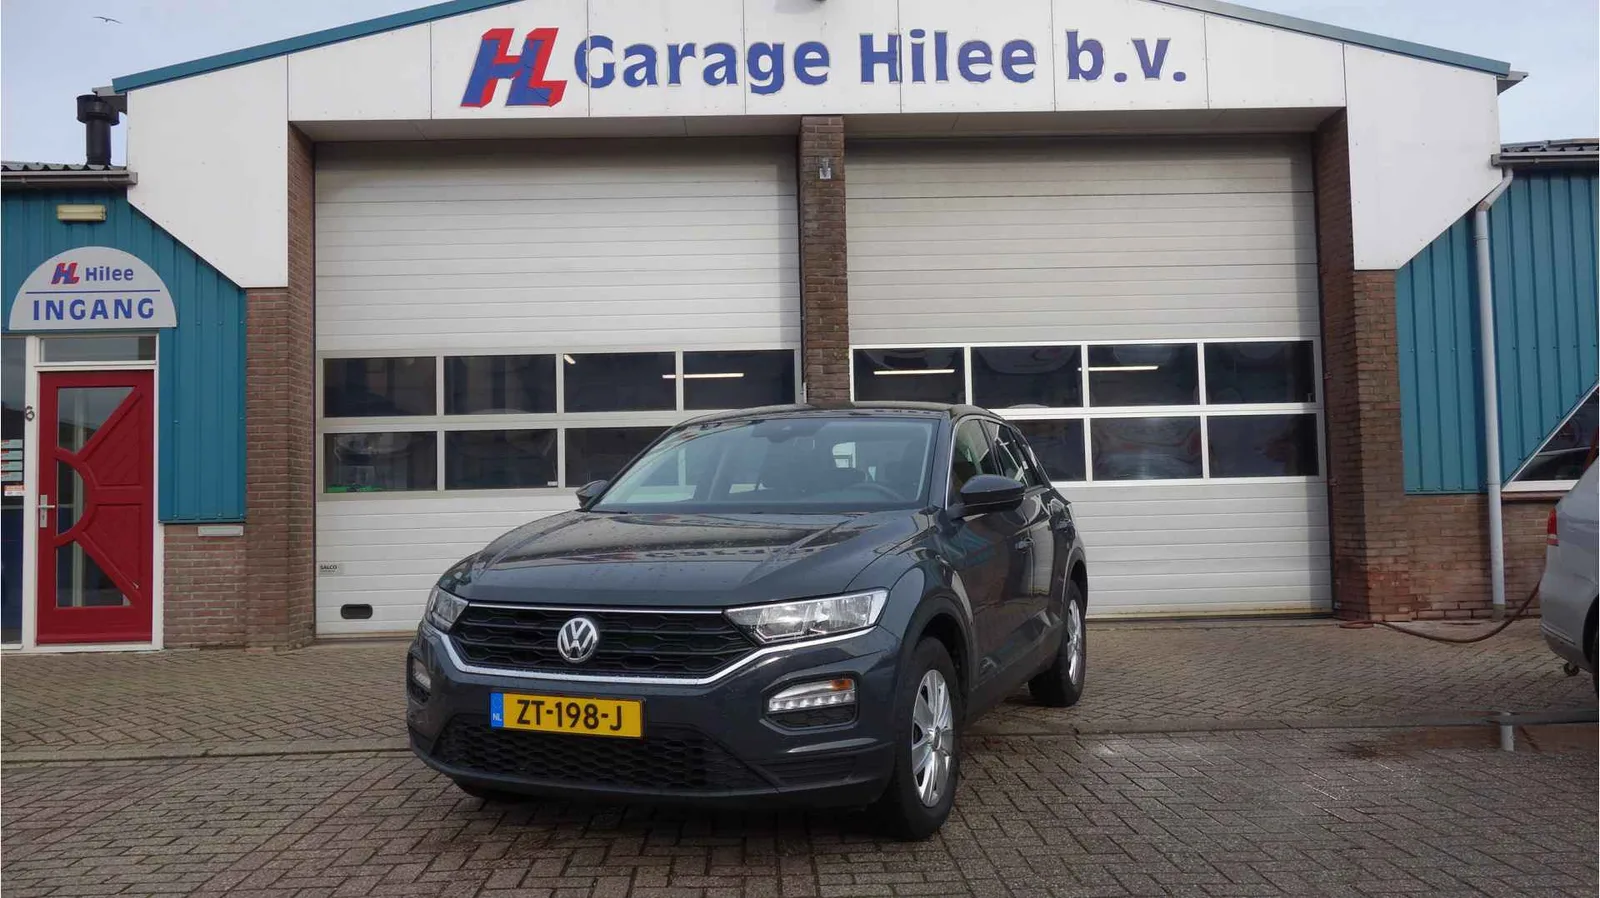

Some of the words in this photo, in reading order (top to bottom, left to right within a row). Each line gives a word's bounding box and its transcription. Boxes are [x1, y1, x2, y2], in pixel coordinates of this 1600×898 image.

[574, 34, 831, 96] Garage
[859, 28, 1036, 84] Hilee
[1066, 28, 1187, 83] b.v.
[86, 266, 134, 282] Hilee
[33, 298, 154, 321] INGANG
[492, 713, 503, 722] NL
[517, 699, 622, 732] ZT-198-J
